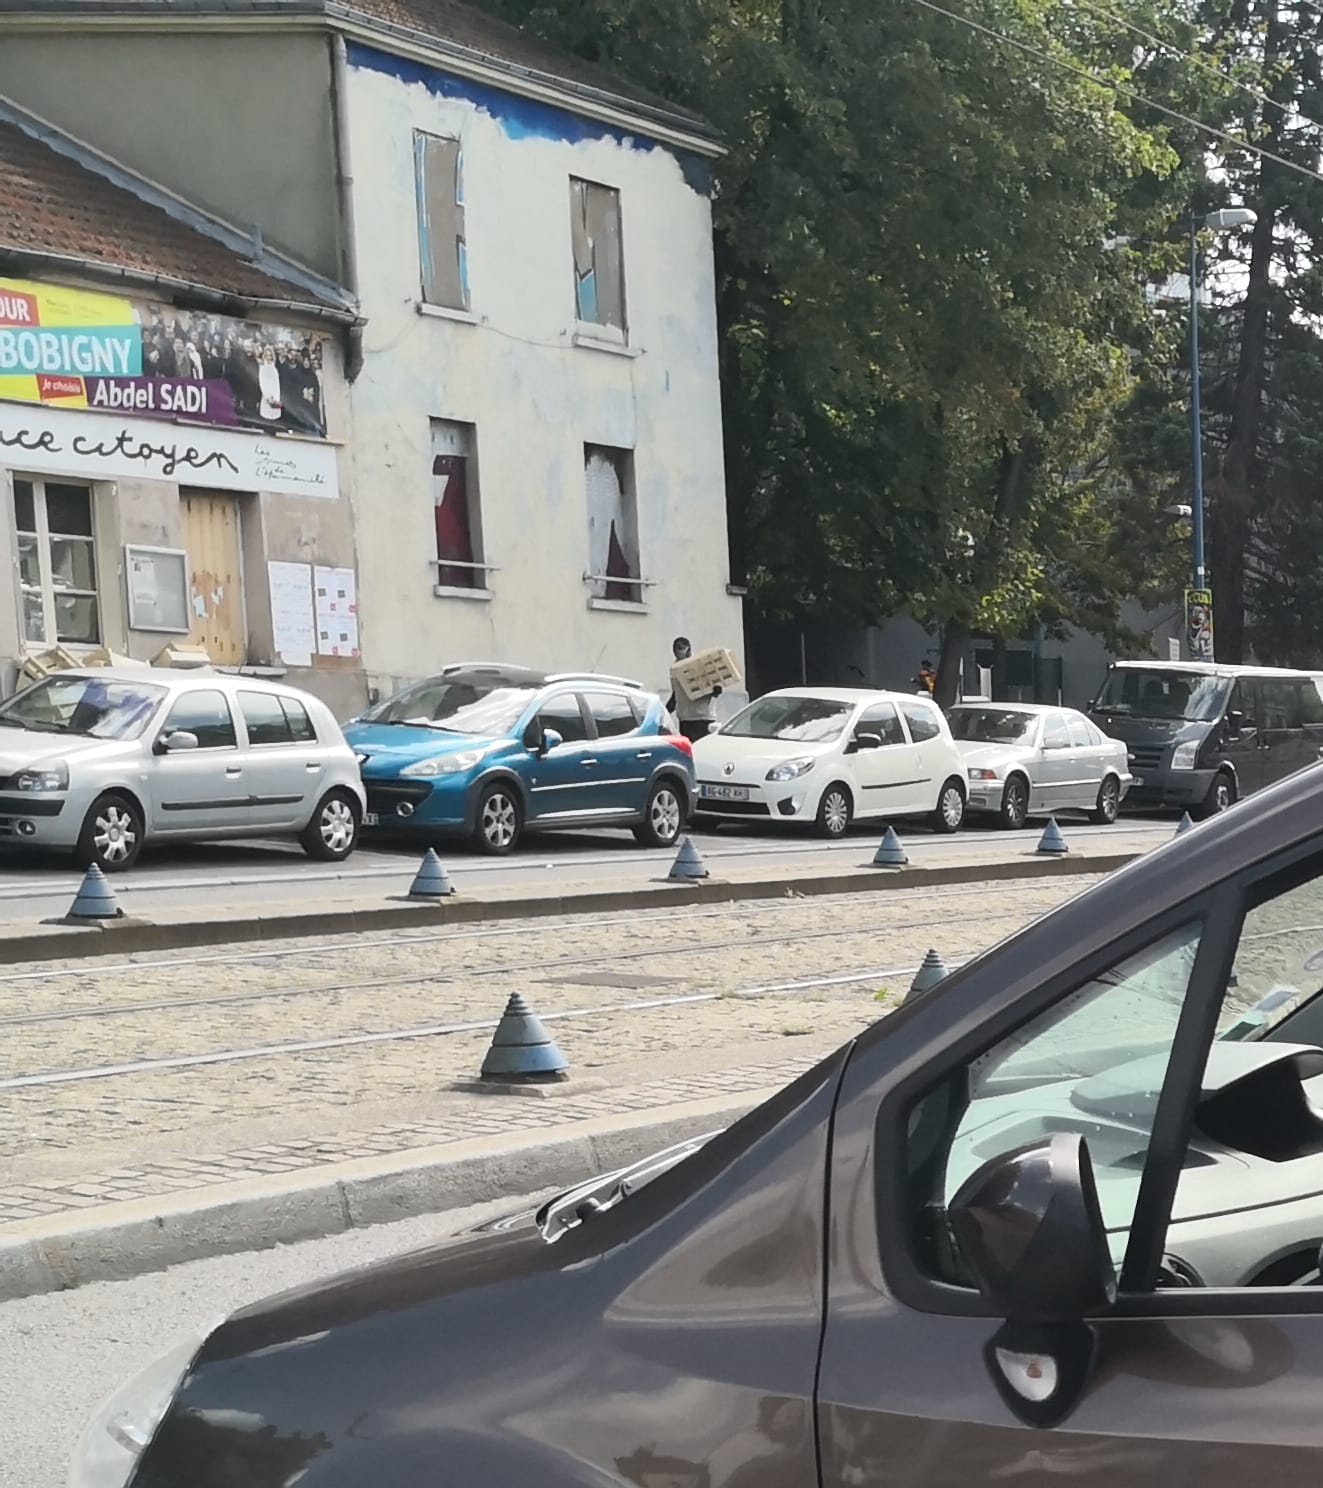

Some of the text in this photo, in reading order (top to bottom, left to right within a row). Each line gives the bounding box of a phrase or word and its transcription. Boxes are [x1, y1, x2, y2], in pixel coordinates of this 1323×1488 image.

[0, 329, 131, 374] BOBIGNY
[93, 379, 207, 414] Abdel SADI
[73, 429, 239, 475] citoyen
